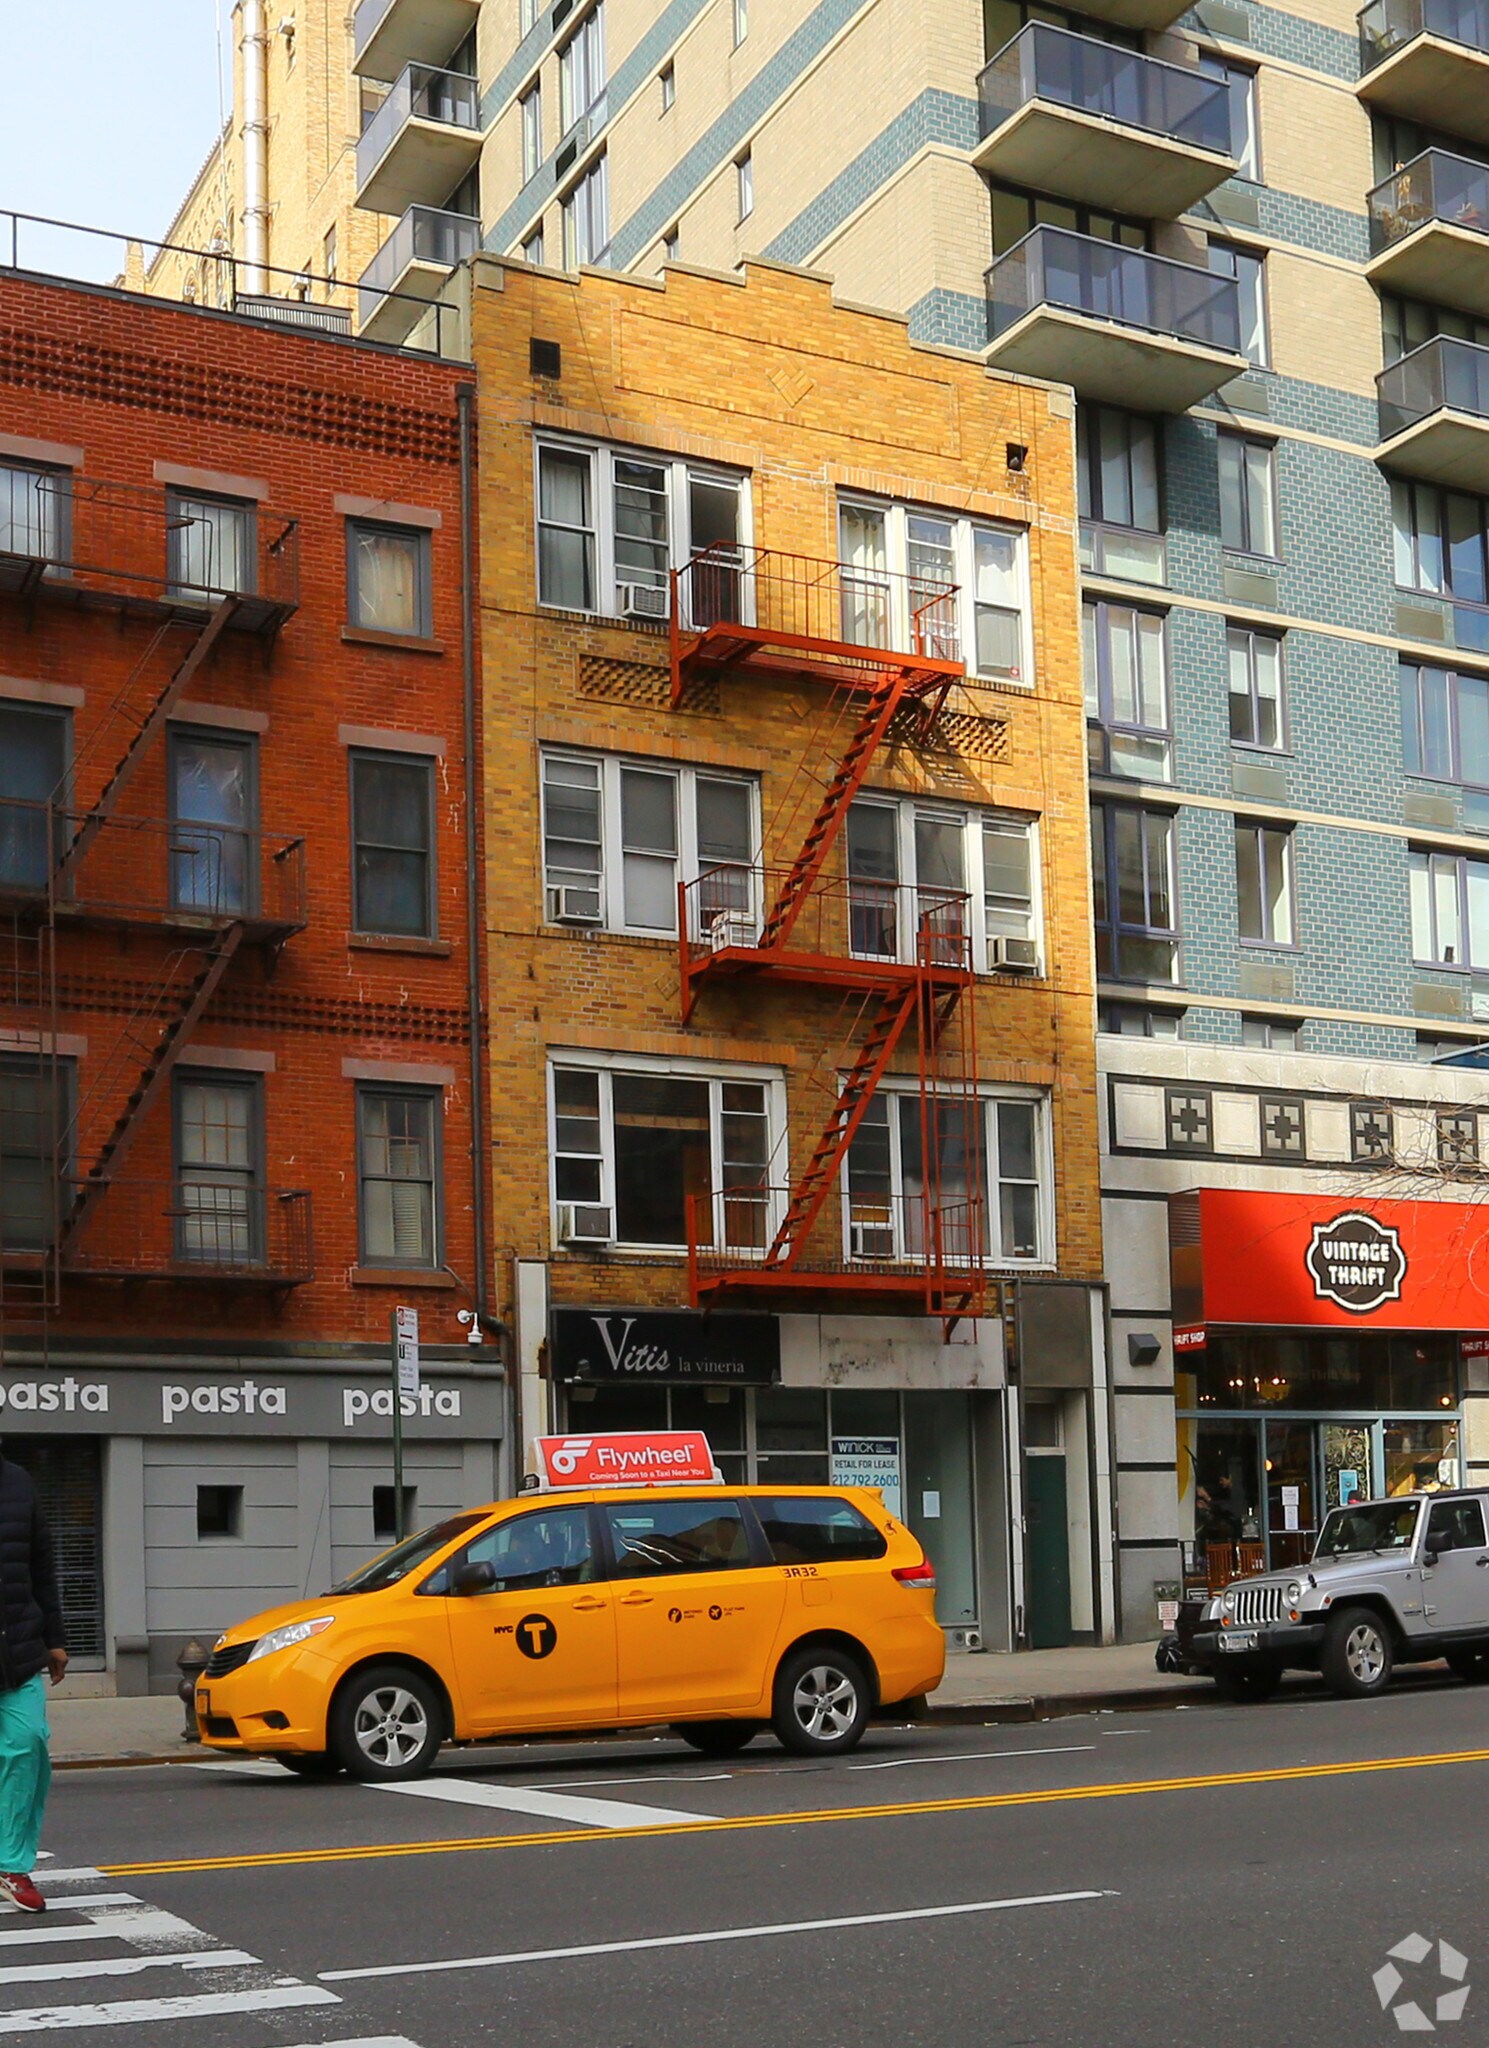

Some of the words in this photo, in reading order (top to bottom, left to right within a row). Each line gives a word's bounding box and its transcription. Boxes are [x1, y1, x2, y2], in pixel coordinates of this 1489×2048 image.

[1322, 1240, 1389, 1262] VINTAGE
[1328, 1265, 1386, 1286] THRIFT
[591, 1316, 670, 1372] Vitis
[679, 1356, 691, 1372] la
[696, 1357, 745, 1373] vineria
[0, 1377, 109, 1411] asta
[162, 1380, 286, 1424] pasta
[589, 1472, 619, 1480] Coming
[671, 1469, 690, 1477] Near
[690, 1468, 705, 1476] You
[834, 1459, 858, 1469] RETAIL
[858, 1459, 873, 1469] FOR
[873, 1459, 896, 1469] LEASE
[832, 1474, 899, 1486] 212.792.2600
[494, 1626, 513, 1634] NYC
[524, 1622, 547, 1653] T
